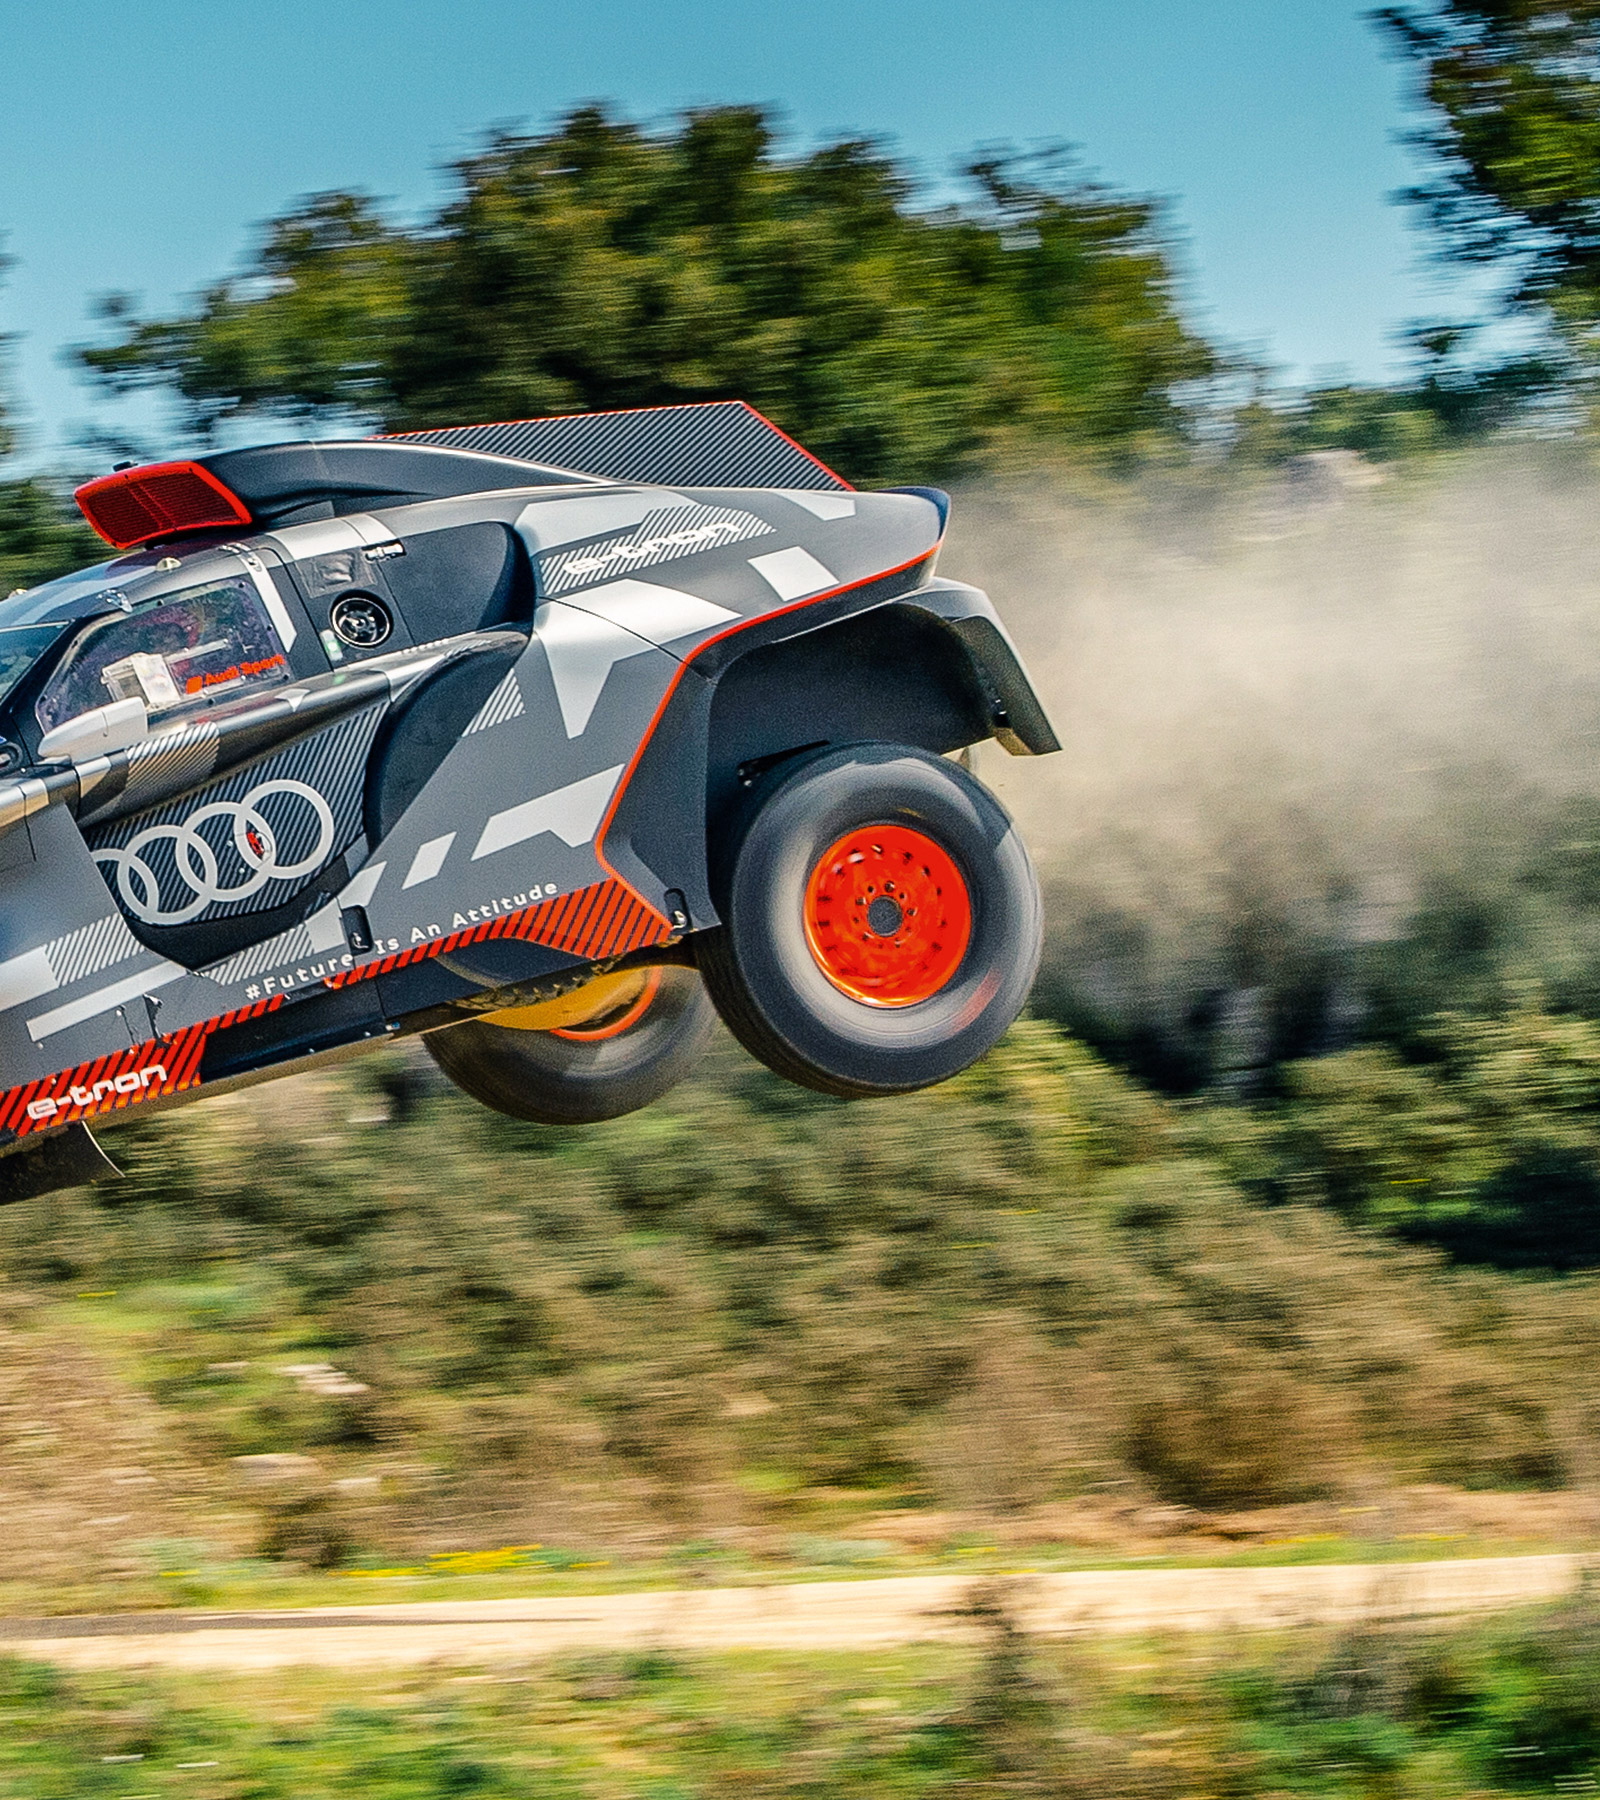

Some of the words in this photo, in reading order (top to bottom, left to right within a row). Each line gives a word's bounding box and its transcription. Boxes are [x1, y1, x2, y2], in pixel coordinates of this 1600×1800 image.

[562, 521, 740, 575] e-tron
[204, 664, 240, 686] Audi
[240, 653, 286, 676] Sport
[244, 953, 354, 1000] #Future
[374, 937, 400, 955] Is
[410, 923, 442, 943] An
[452, 883, 558, 929] Attitude
[26, 1064, 168, 1120] e-tron
